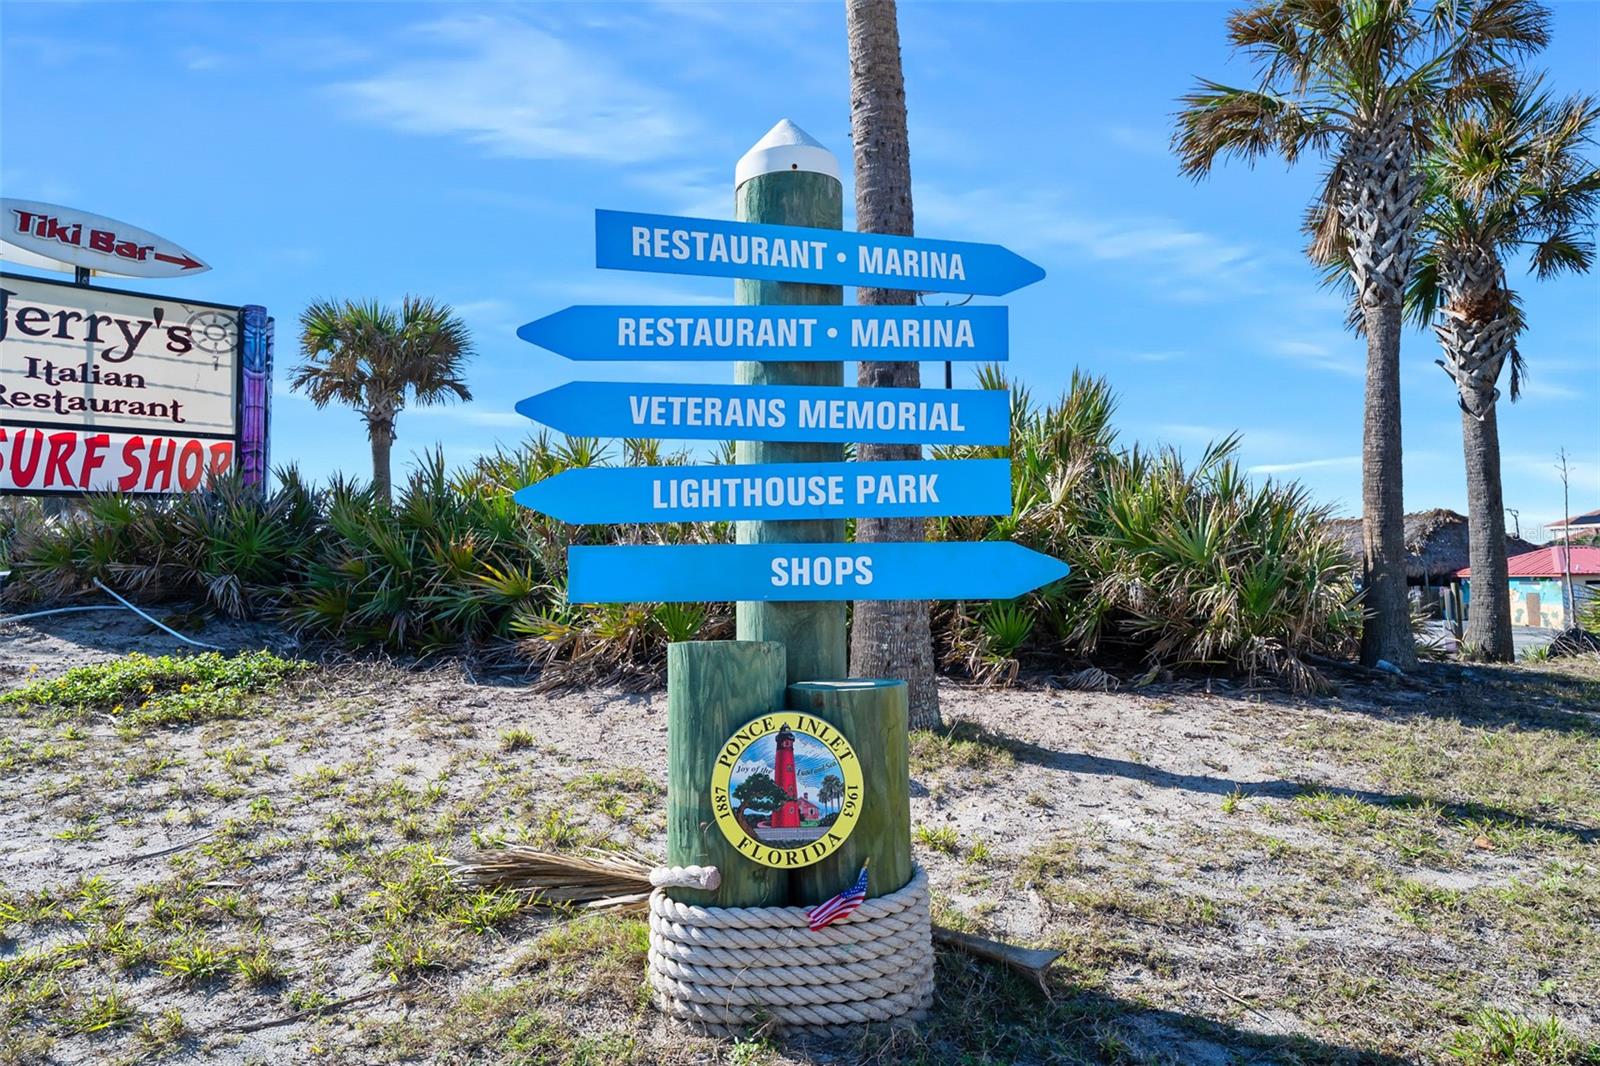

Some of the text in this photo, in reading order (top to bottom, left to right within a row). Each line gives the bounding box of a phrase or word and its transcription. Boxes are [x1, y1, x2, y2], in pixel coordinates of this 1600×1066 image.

[13, 209, 155, 261] Tiki Bar
[632, 226, 966, 281] RESTAURANT MARINA
[618, 318, 975, 348] RESTAURANT MARINA
[24, 356, 147, 389] Italian
[629, 396, 965, 432] VETERANS MEMORIAL
[653, 474, 939, 509] LIGHTHOUSE PARK
[771, 556, 873, 586] SHOPS
[718, 716, 854, 769] PONCE INLET
[715, 786, 731, 819] 1887
[843, 785, 858, 818] 1963
[737, 833, 843, 865] FLORIDA
